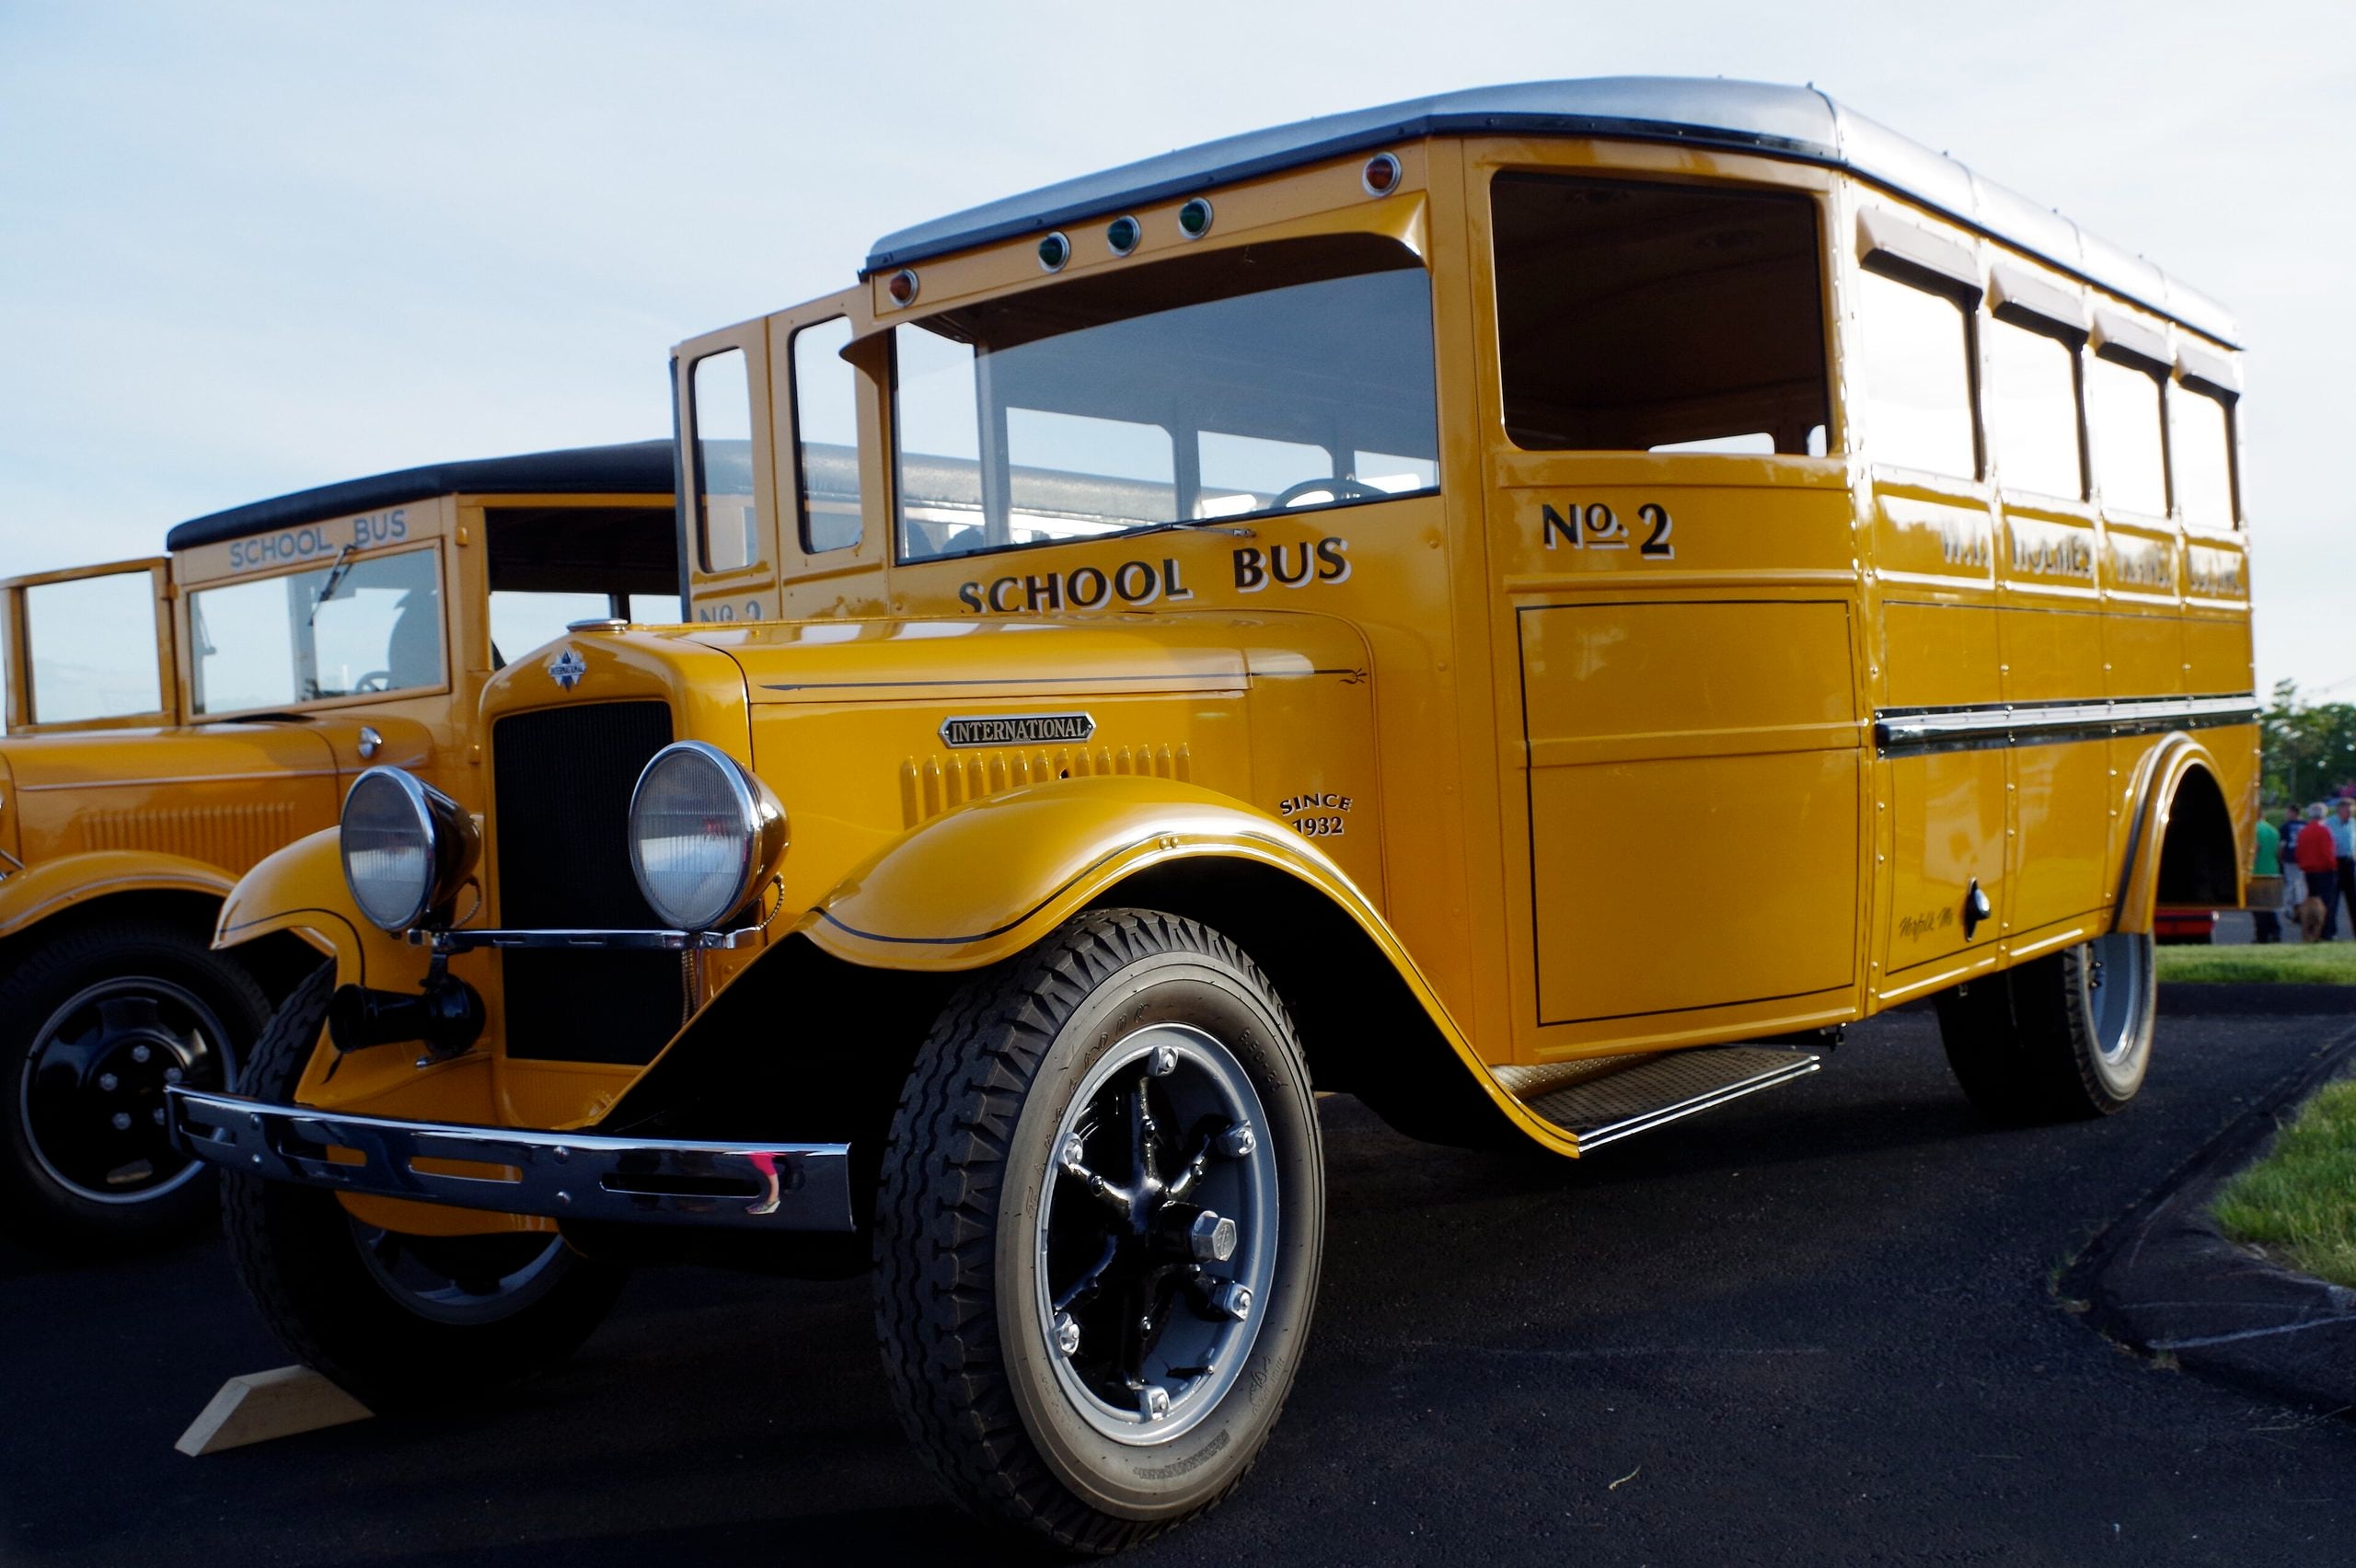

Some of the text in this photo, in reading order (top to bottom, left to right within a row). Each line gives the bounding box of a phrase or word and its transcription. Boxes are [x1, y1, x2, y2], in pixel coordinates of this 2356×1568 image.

[229, 510, 409, 570] SCHOOL BUS
[1637, 503, 1675, 559] 2
[959, 536, 1352, 614] SCHOOL BUS
[952, 718, 1089, 743] INTERNATIONAL
[1279, 792, 1354, 817] SINCE
[1292, 816, 1345, 837] 1932
